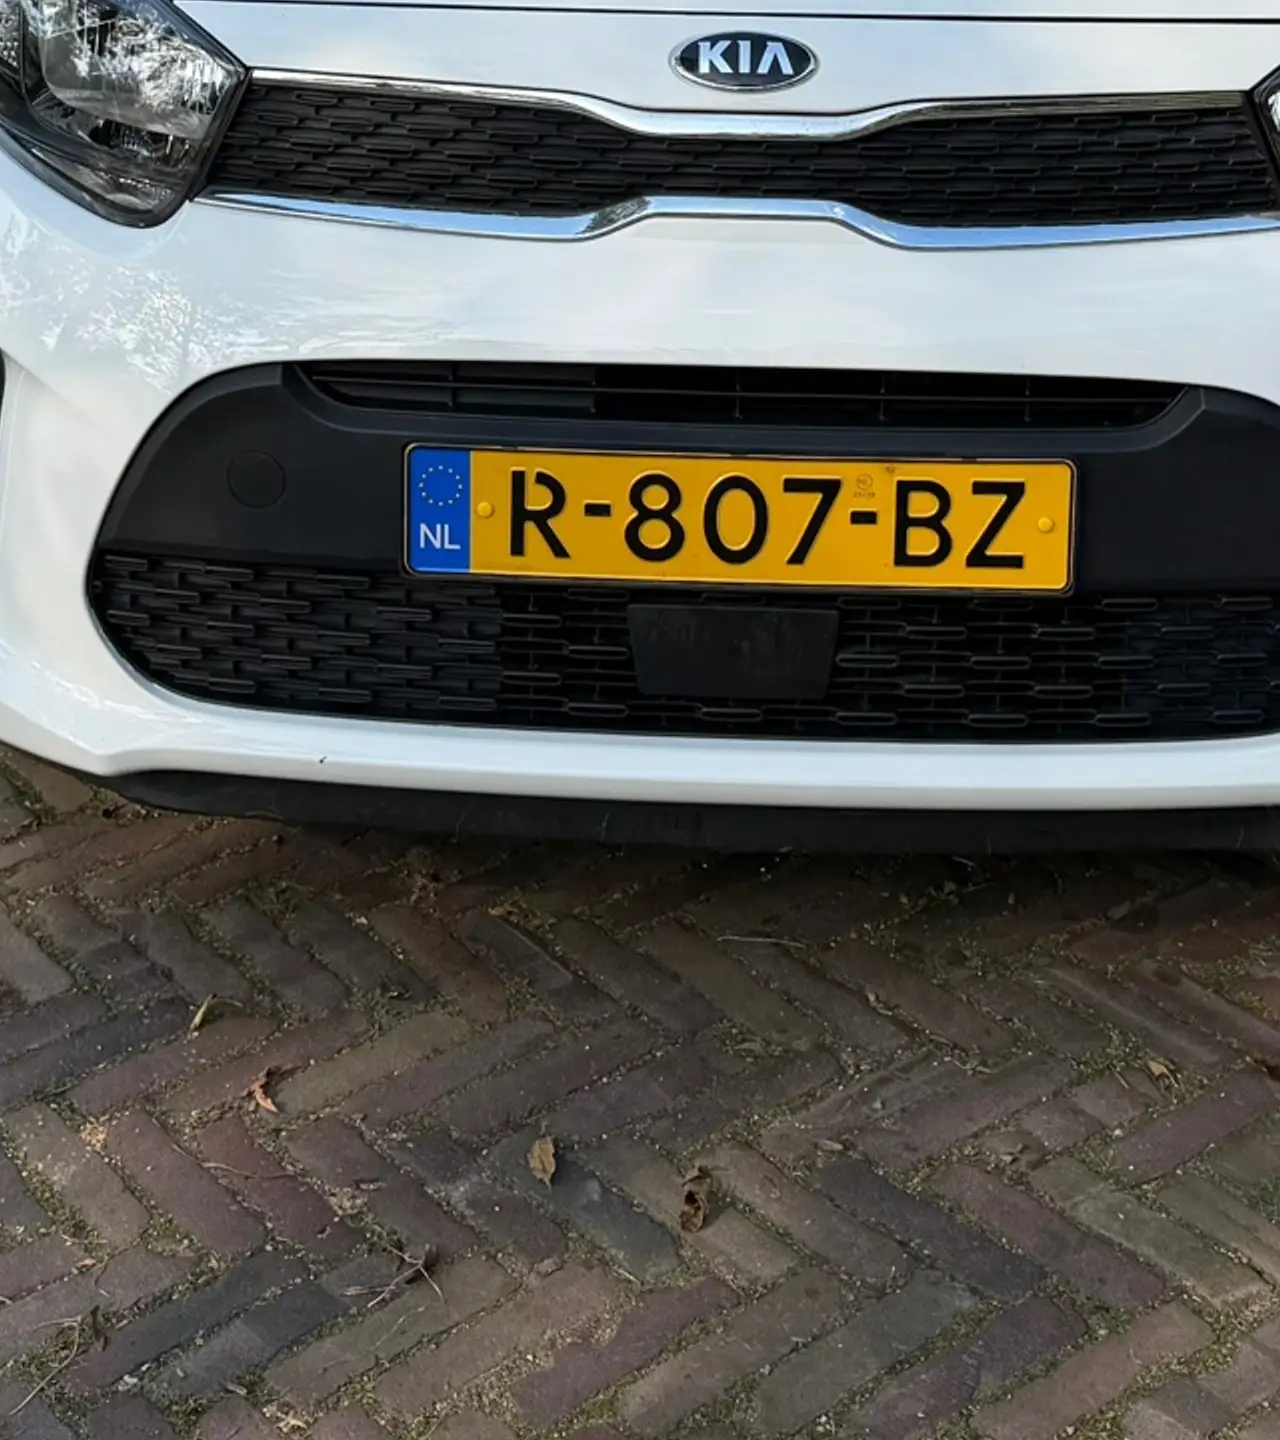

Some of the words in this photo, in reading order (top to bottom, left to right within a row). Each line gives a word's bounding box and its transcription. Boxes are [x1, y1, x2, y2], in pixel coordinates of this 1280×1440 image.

[697, 40, 794, 75] KIA
[420, 522, 461, 550] NL
[508, 469, 1026, 570] R-807-BZ
